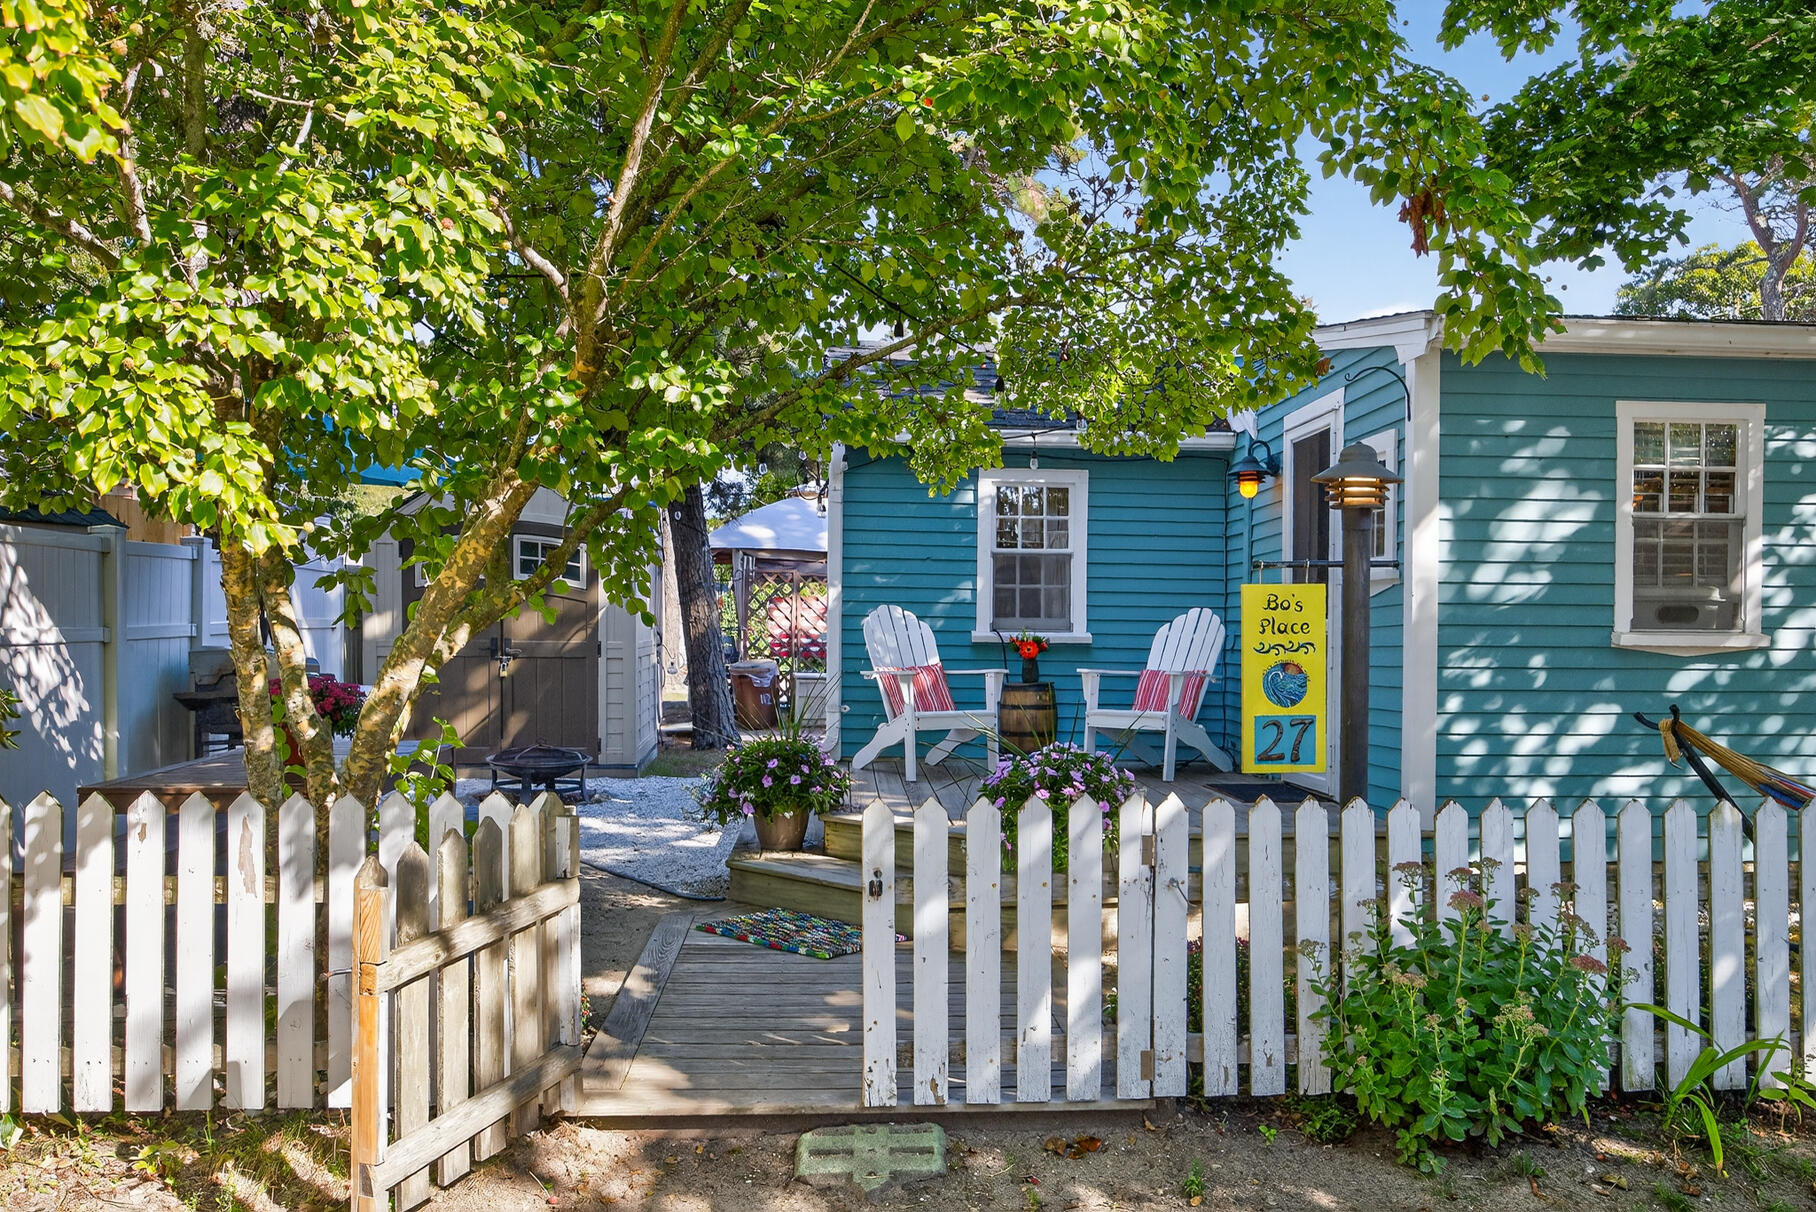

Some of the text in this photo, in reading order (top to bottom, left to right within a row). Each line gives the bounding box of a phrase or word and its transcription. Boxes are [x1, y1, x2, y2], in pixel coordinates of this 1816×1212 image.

[1263, 593, 1304, 613] Bo's
[1258, 616, 1311, 635] Place
[1257, 718, 1314, 762] 27
